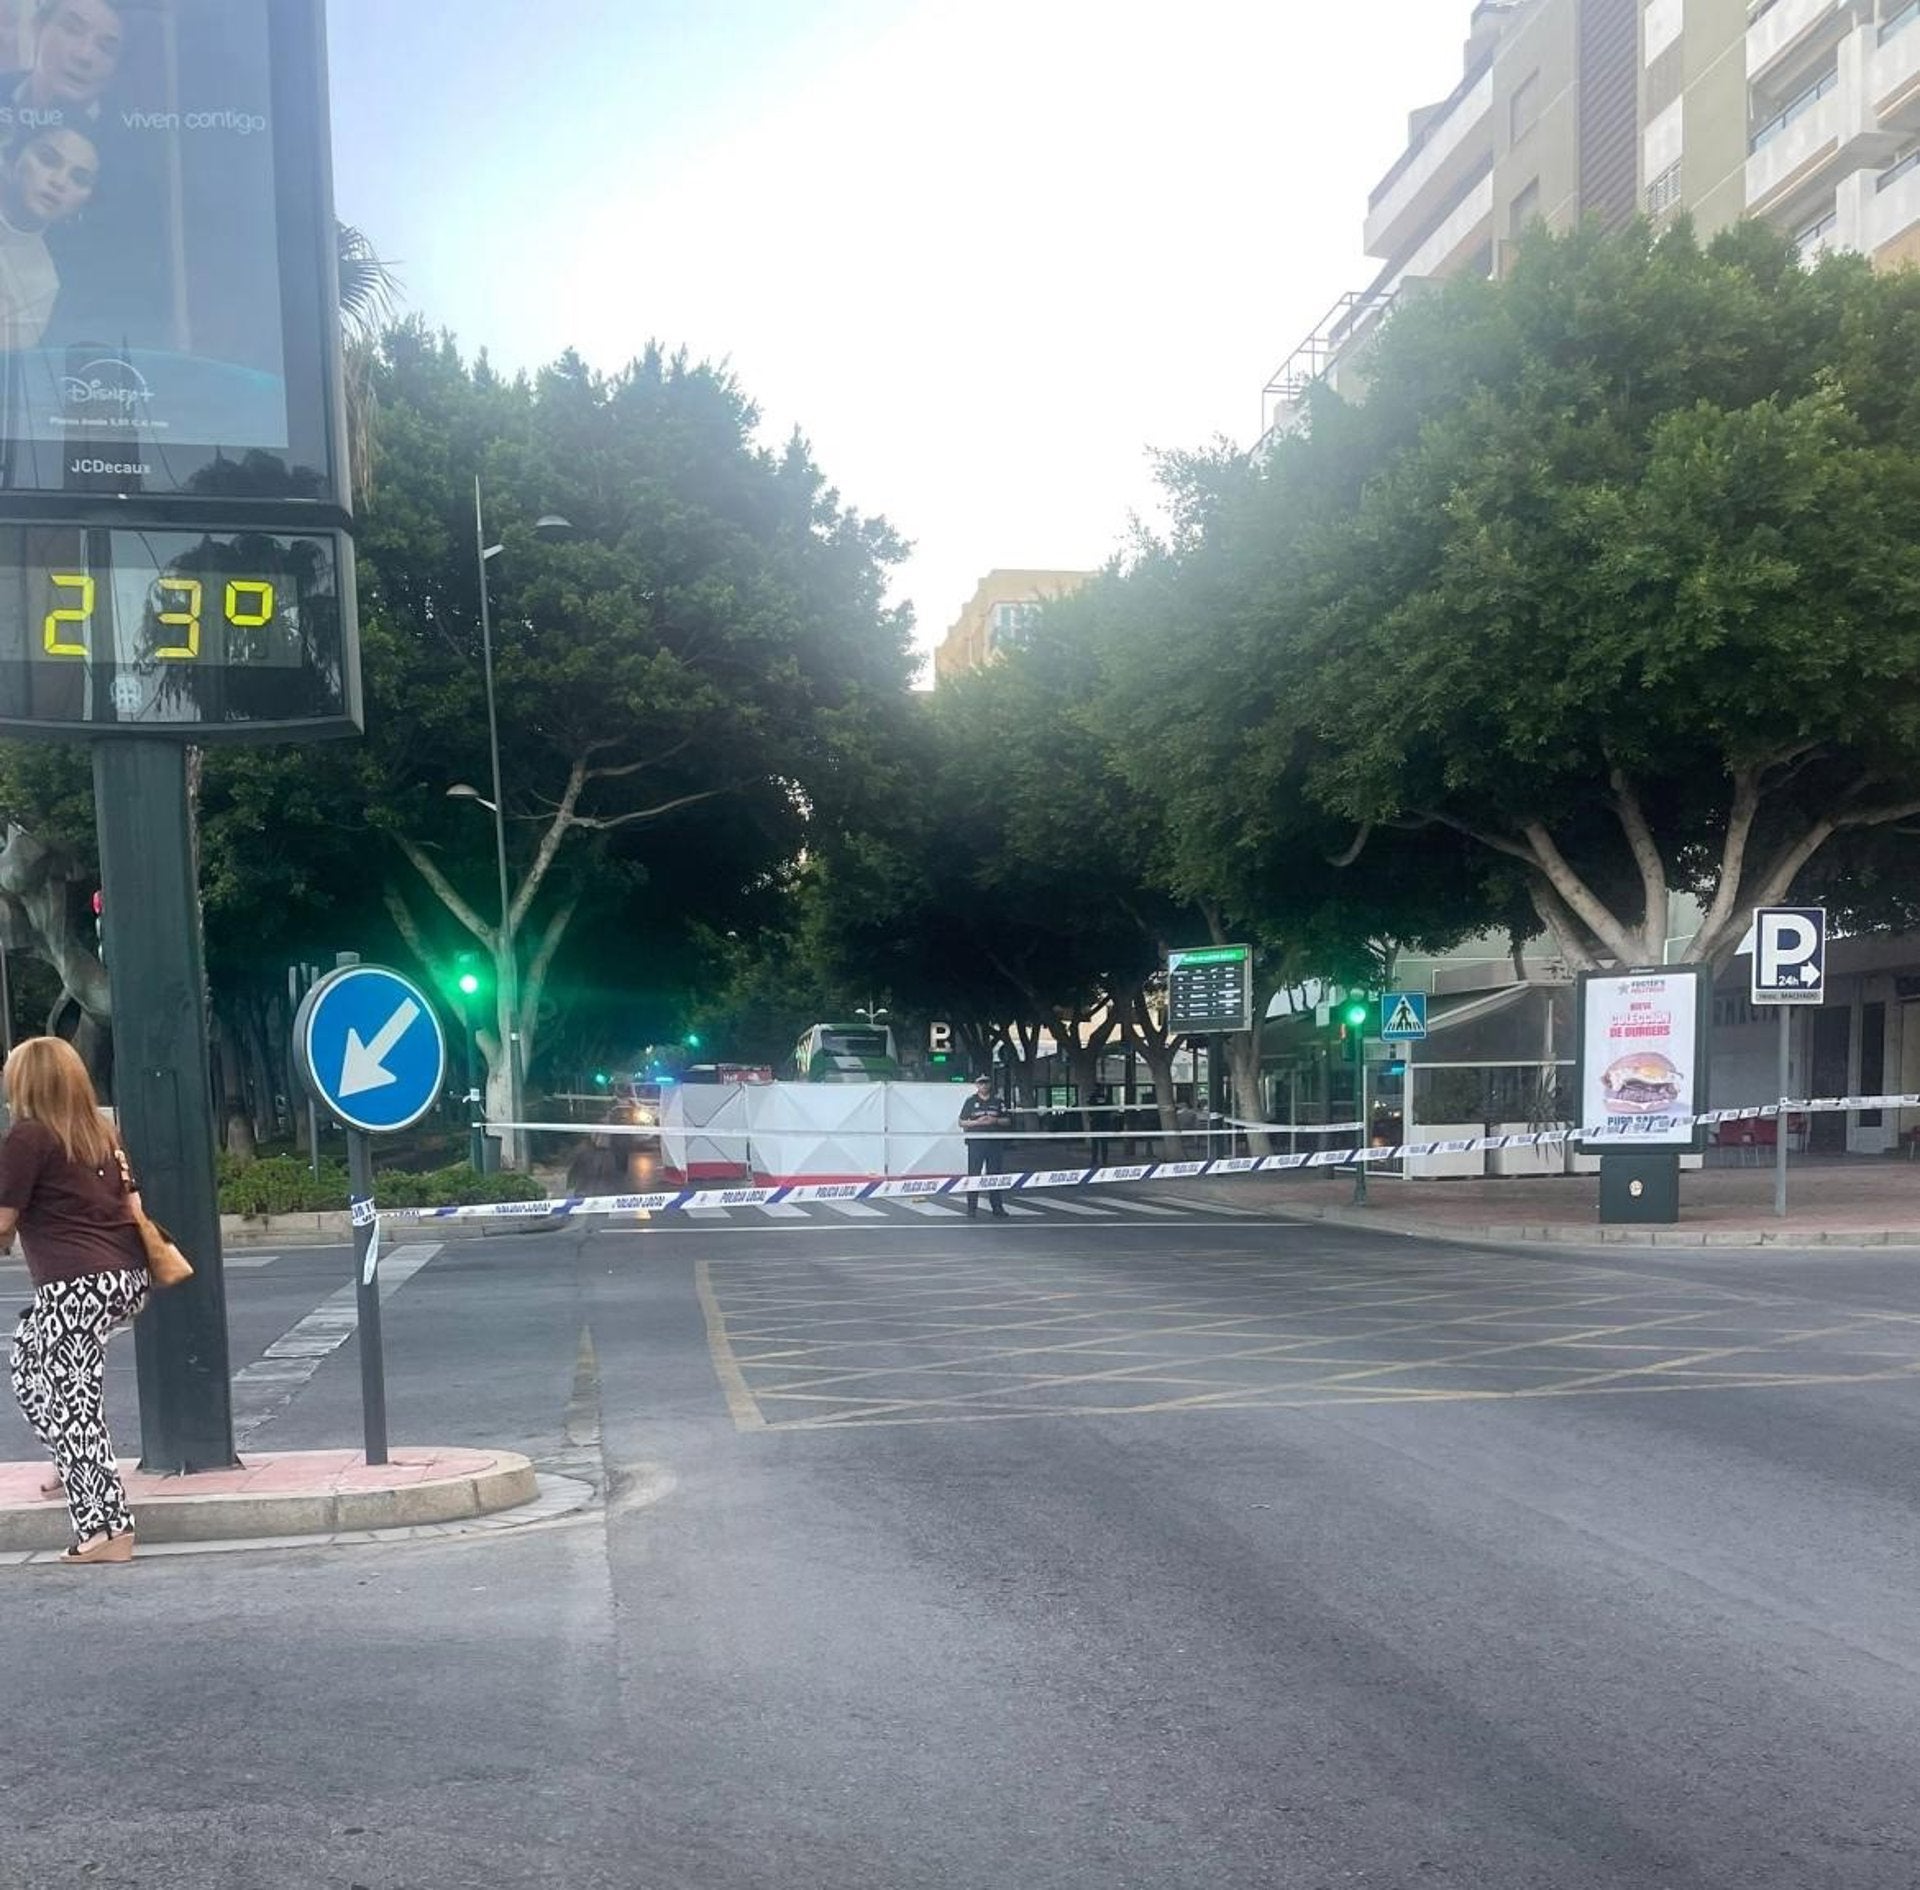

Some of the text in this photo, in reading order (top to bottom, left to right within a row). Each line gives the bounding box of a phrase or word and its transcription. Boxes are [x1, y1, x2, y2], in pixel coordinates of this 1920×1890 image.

[19, 107, 63, 130] que
[121, 112, 179, 130] viven
[184, 111, 266, 135] contigo
[70, 458, 151, 475] JCDecaux
[1761, 913, 1818, 987] P
[815, 1185, 857, 1198] POLICIA LOCAL
[921, 1181, 938, 1192] LOCAL
[745, 1190, 767, 1202] LOCAL
